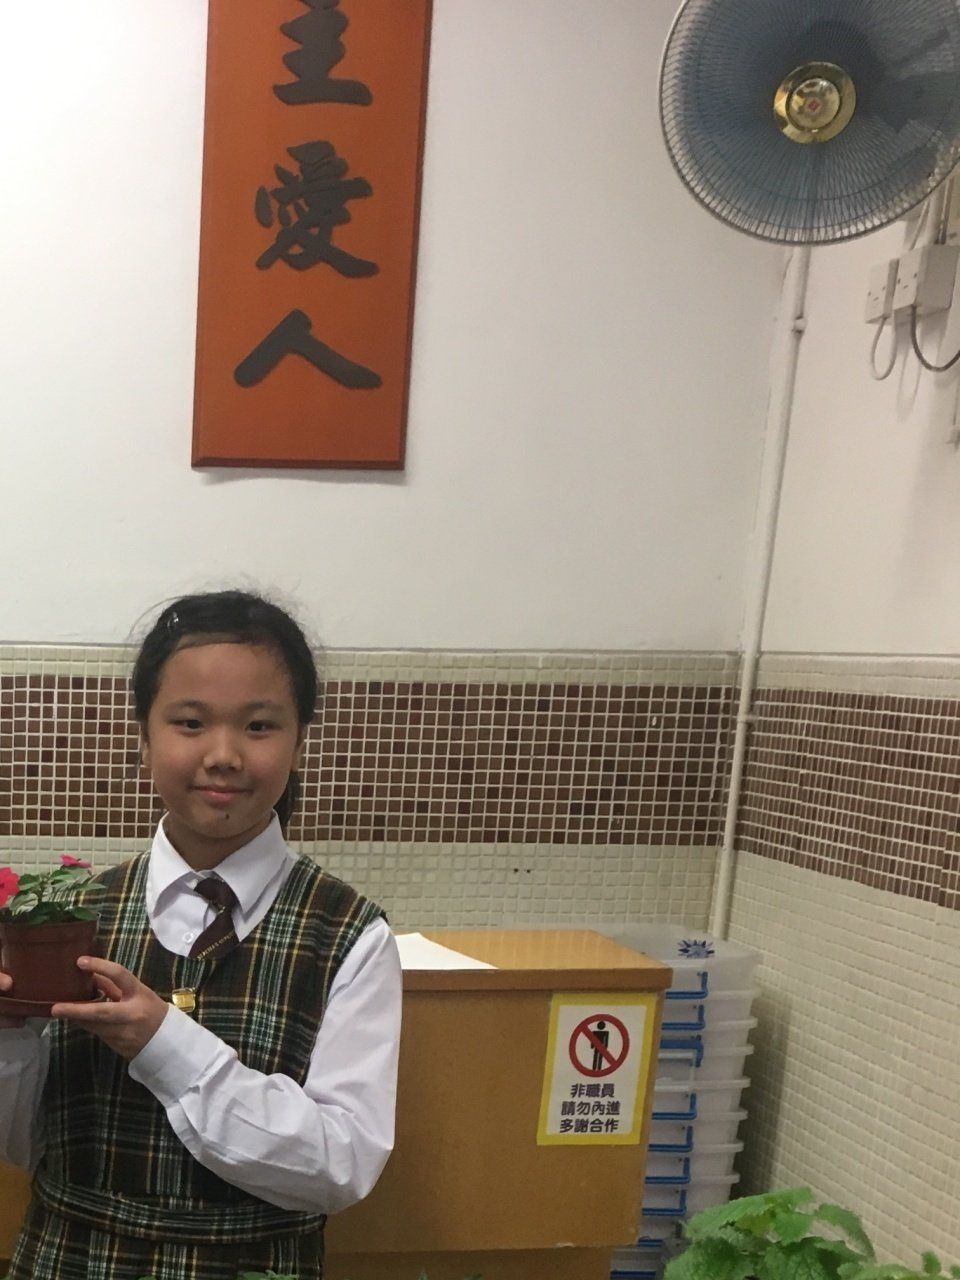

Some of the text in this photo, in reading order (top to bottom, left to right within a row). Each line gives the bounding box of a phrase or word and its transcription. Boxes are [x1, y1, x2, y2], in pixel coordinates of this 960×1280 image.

[570, 1083, 615, 1098] 非職員
[559, 1118, 619, 1133] 多謝合作
